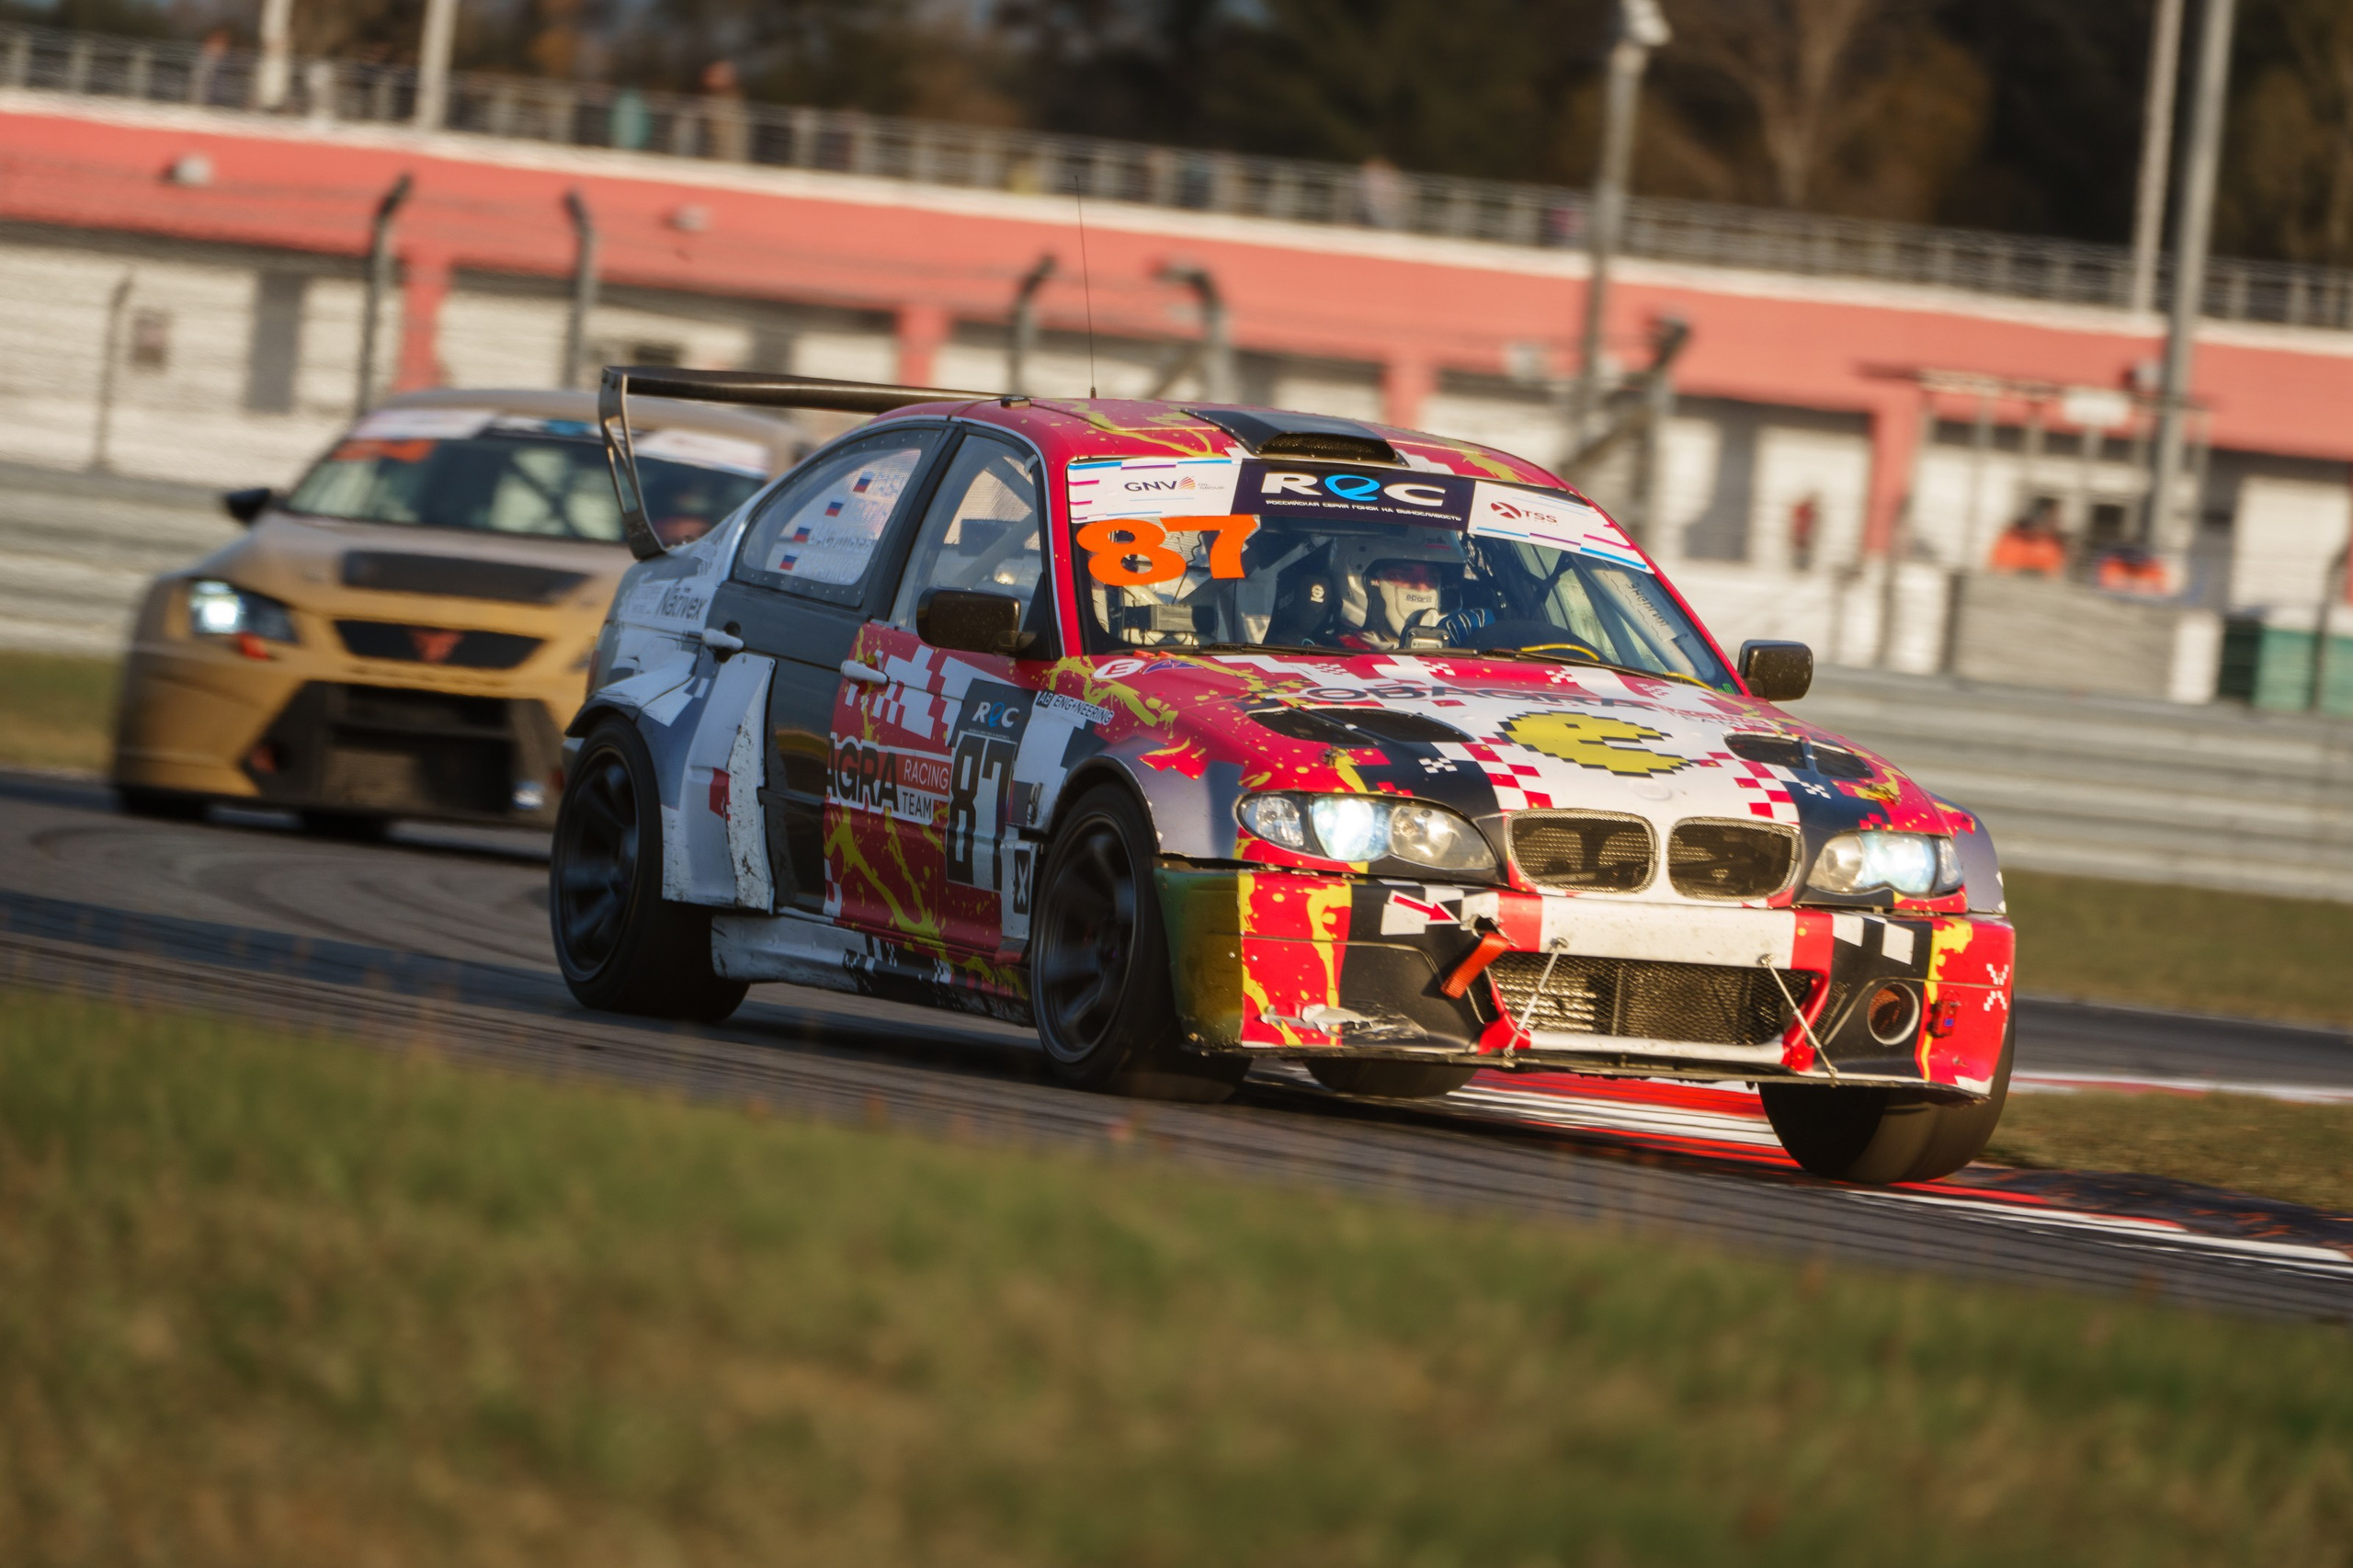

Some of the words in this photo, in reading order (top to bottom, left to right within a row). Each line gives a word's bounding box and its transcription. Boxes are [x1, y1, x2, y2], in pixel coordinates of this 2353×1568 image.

[1124, 480, 1177, 492] GNV
[1266, 499, 1320, 507] РОССИЙСКАЯ
[1396, 508, 1462, 522] ВЫНОСЛИВОСТЬ
[1522, 509, 1558, 523] TSS
[1076, 514, 1258, 586] 87
[1038, 691, 1052, 707] AB
[904, 759, 949, 790] RACING
[902, 791, 932, 820] TEAM
[947, 733, 1017, 892] 87
